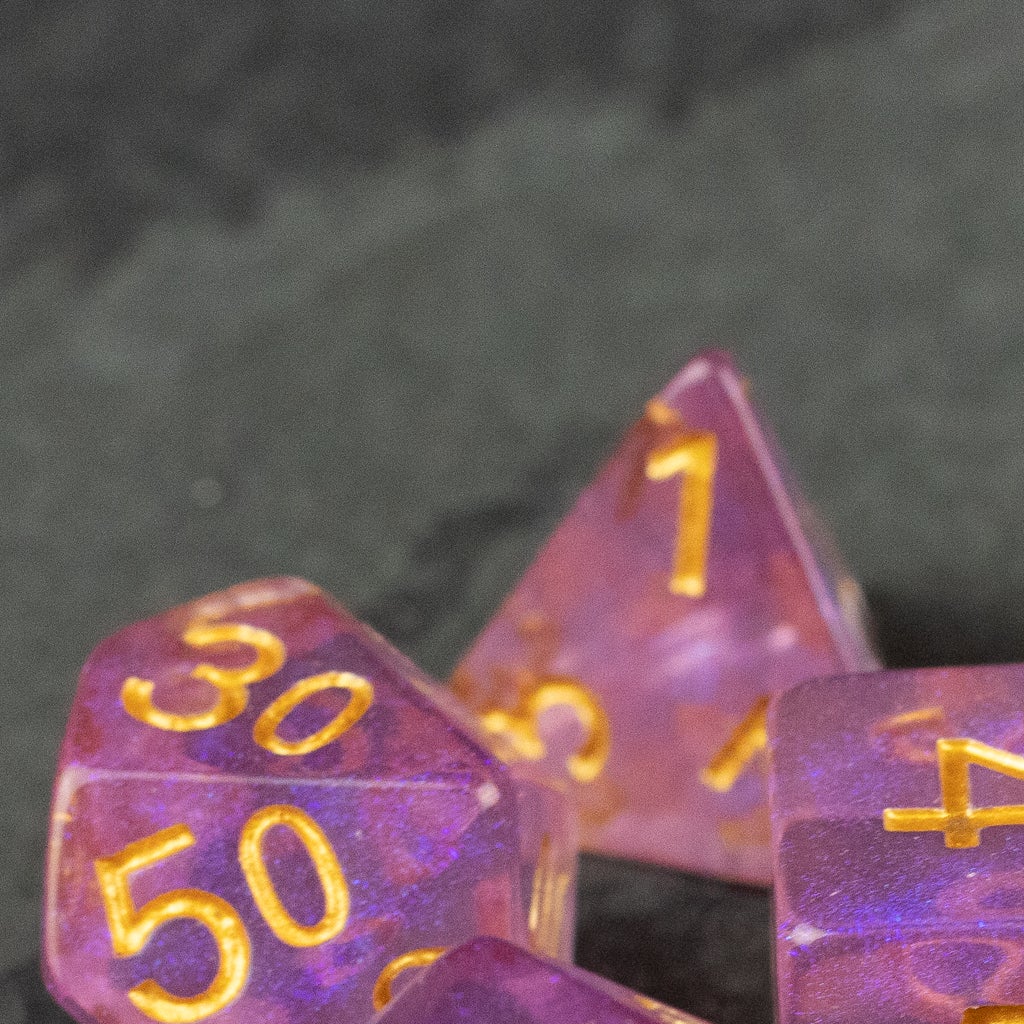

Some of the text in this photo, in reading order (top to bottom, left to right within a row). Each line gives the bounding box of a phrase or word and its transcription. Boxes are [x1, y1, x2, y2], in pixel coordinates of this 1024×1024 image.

[647, 432, 718, 598] 1
[121, 623, 374, 756] 30
[93, 804, 349, 1024] 50
